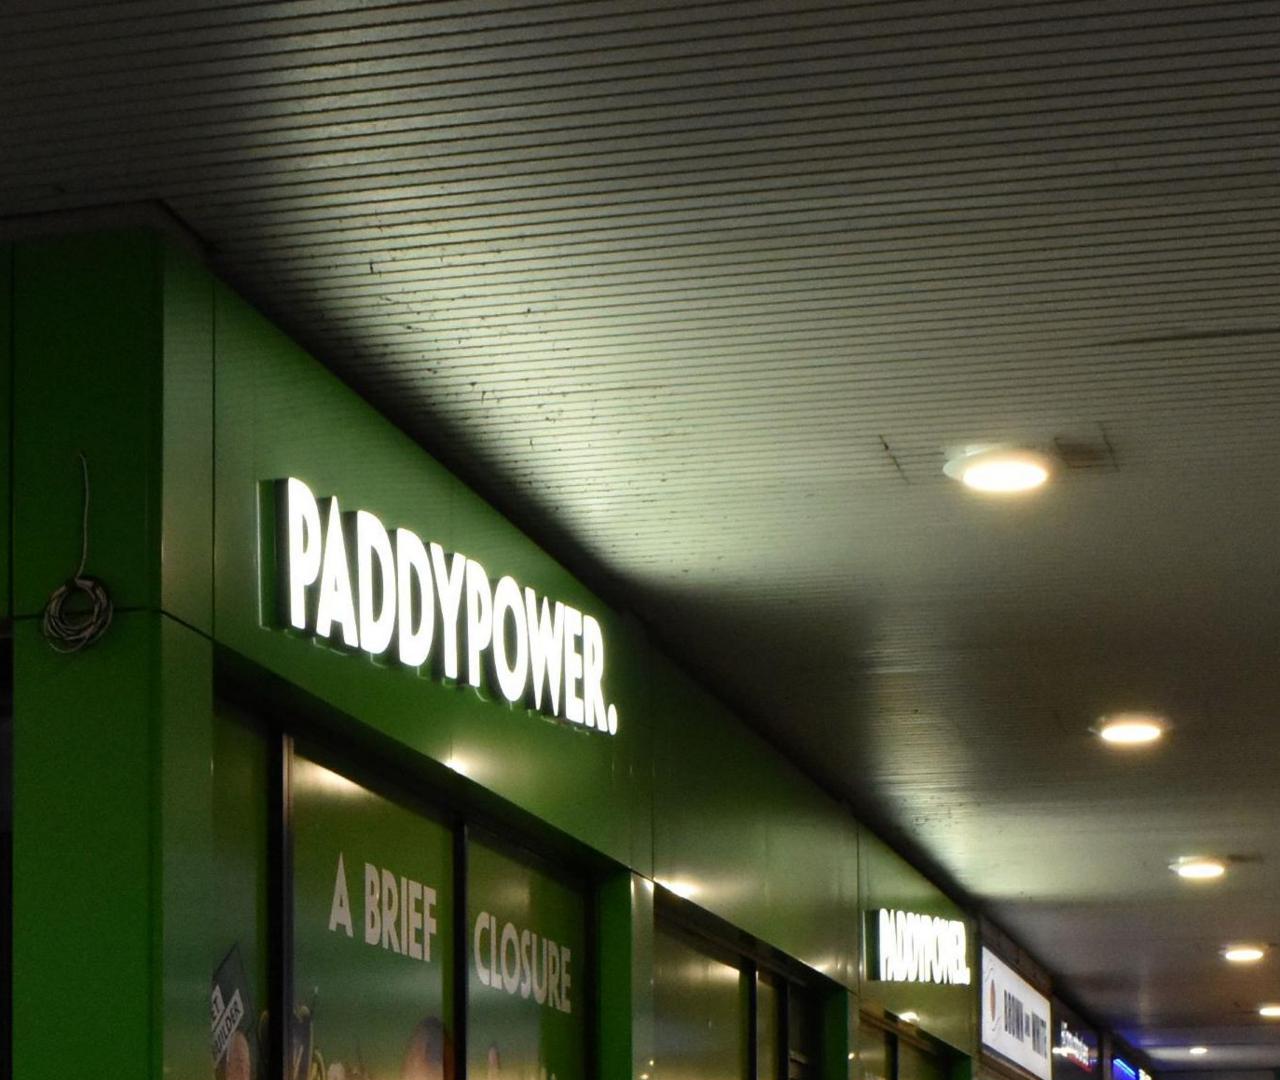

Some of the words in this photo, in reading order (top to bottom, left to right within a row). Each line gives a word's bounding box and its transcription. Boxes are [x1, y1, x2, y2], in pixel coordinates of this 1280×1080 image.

[285, 476, 618, 736] PADDYPOWER.
[328, 852, 353, 939] A
[364, 861, 438, 964] BRIEF
[473, 911, 572, 1014] CLOSURE
